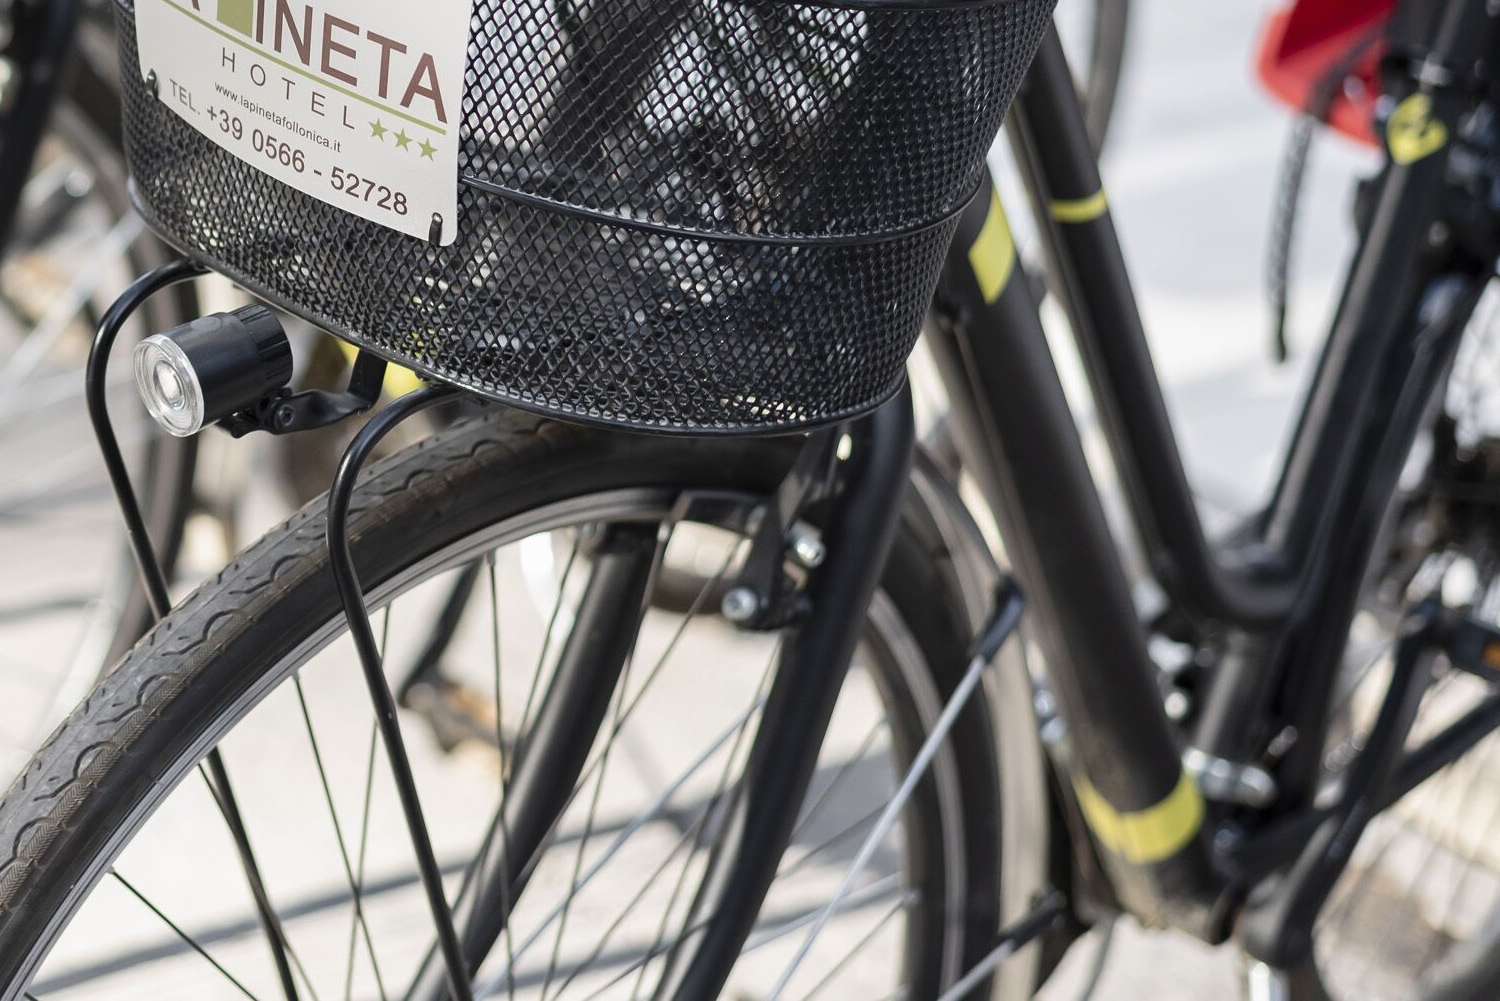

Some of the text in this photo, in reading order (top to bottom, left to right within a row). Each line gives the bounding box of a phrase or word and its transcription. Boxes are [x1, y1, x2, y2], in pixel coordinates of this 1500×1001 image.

[214, 81, 341, 153] www.lapinetafollonica.it
[222, 47, 355, 130] HOTEL
[169, 78, 201, 116] TEL.
[206, 105, 243, 141] +39
[252, 128, 306, 174] 0566
[330, 165, 408, 216] 52728
